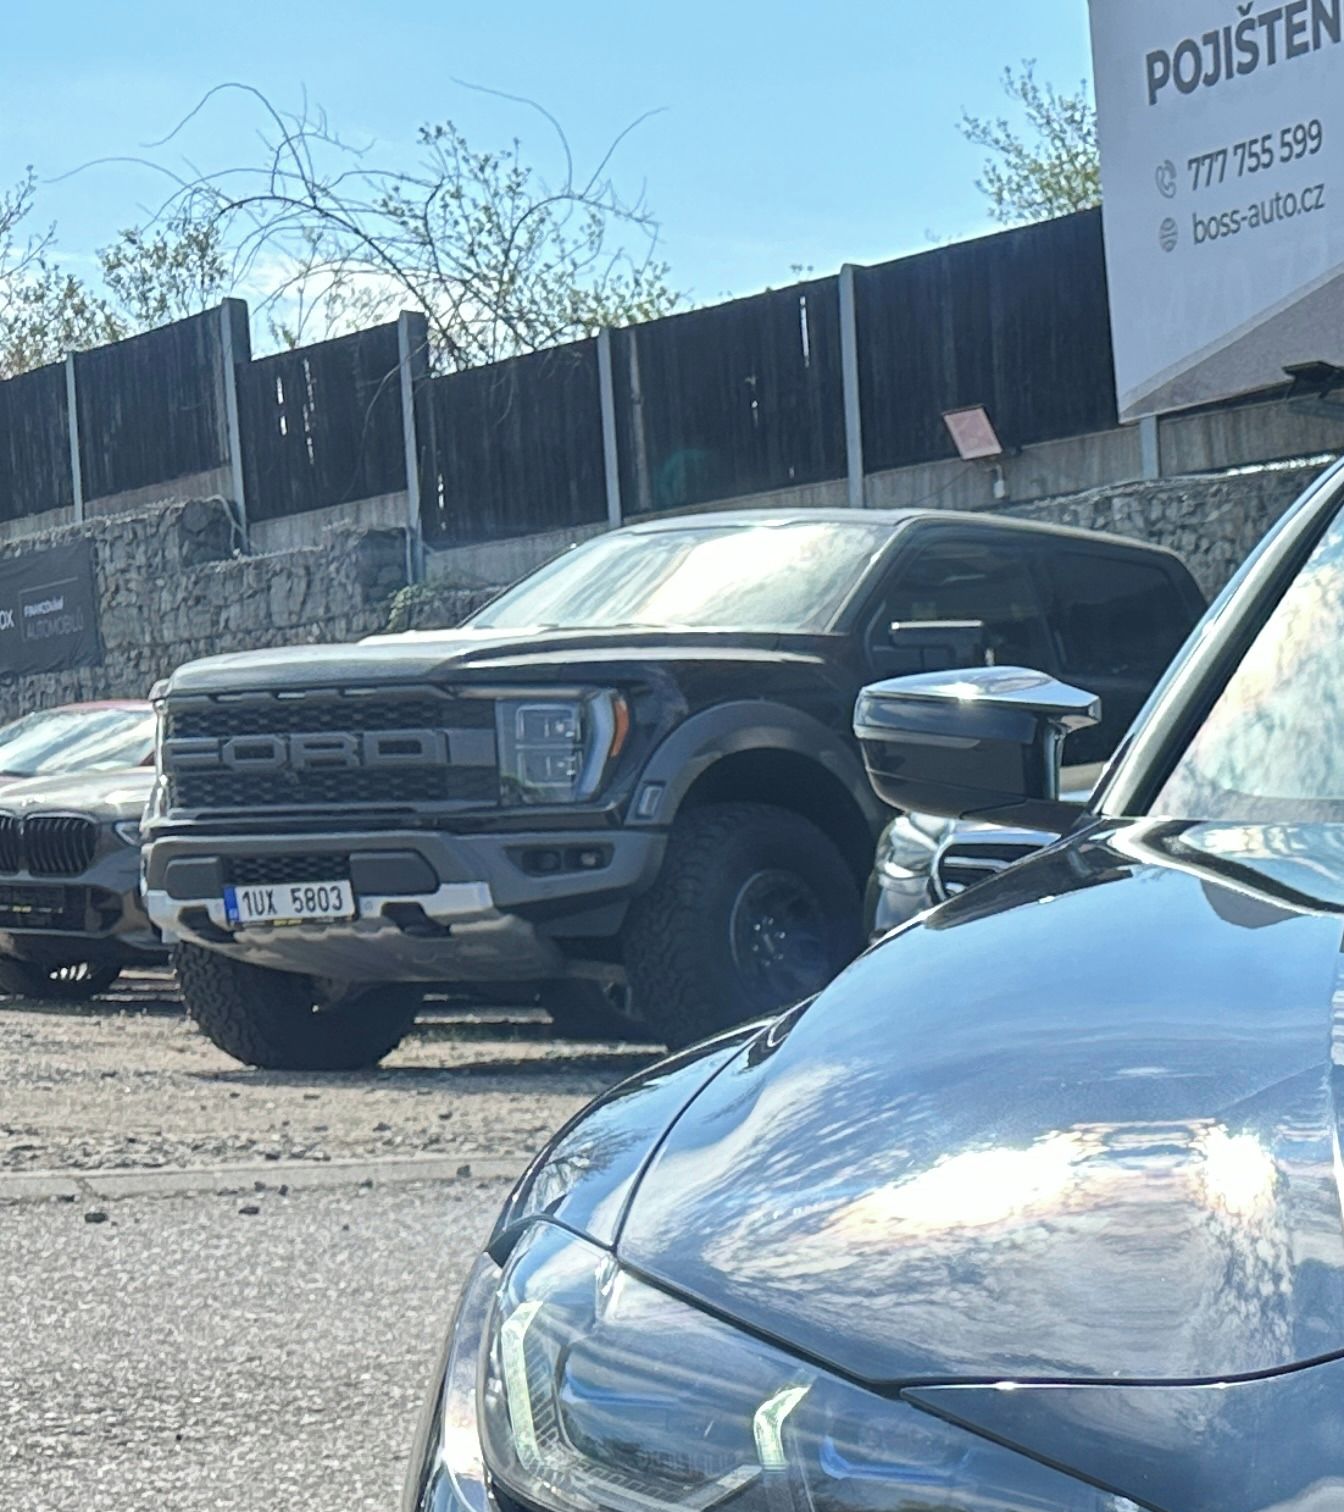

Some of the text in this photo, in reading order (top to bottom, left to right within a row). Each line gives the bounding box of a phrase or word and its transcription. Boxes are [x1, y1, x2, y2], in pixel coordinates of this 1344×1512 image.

[1187, 119, 1323, 191] 777 755 599
[1192, 184, 1325, 245] boss-auto.cz
[163, 729, 451, 773] FORD
[242, 886, 343, 916] 1UX 5803
